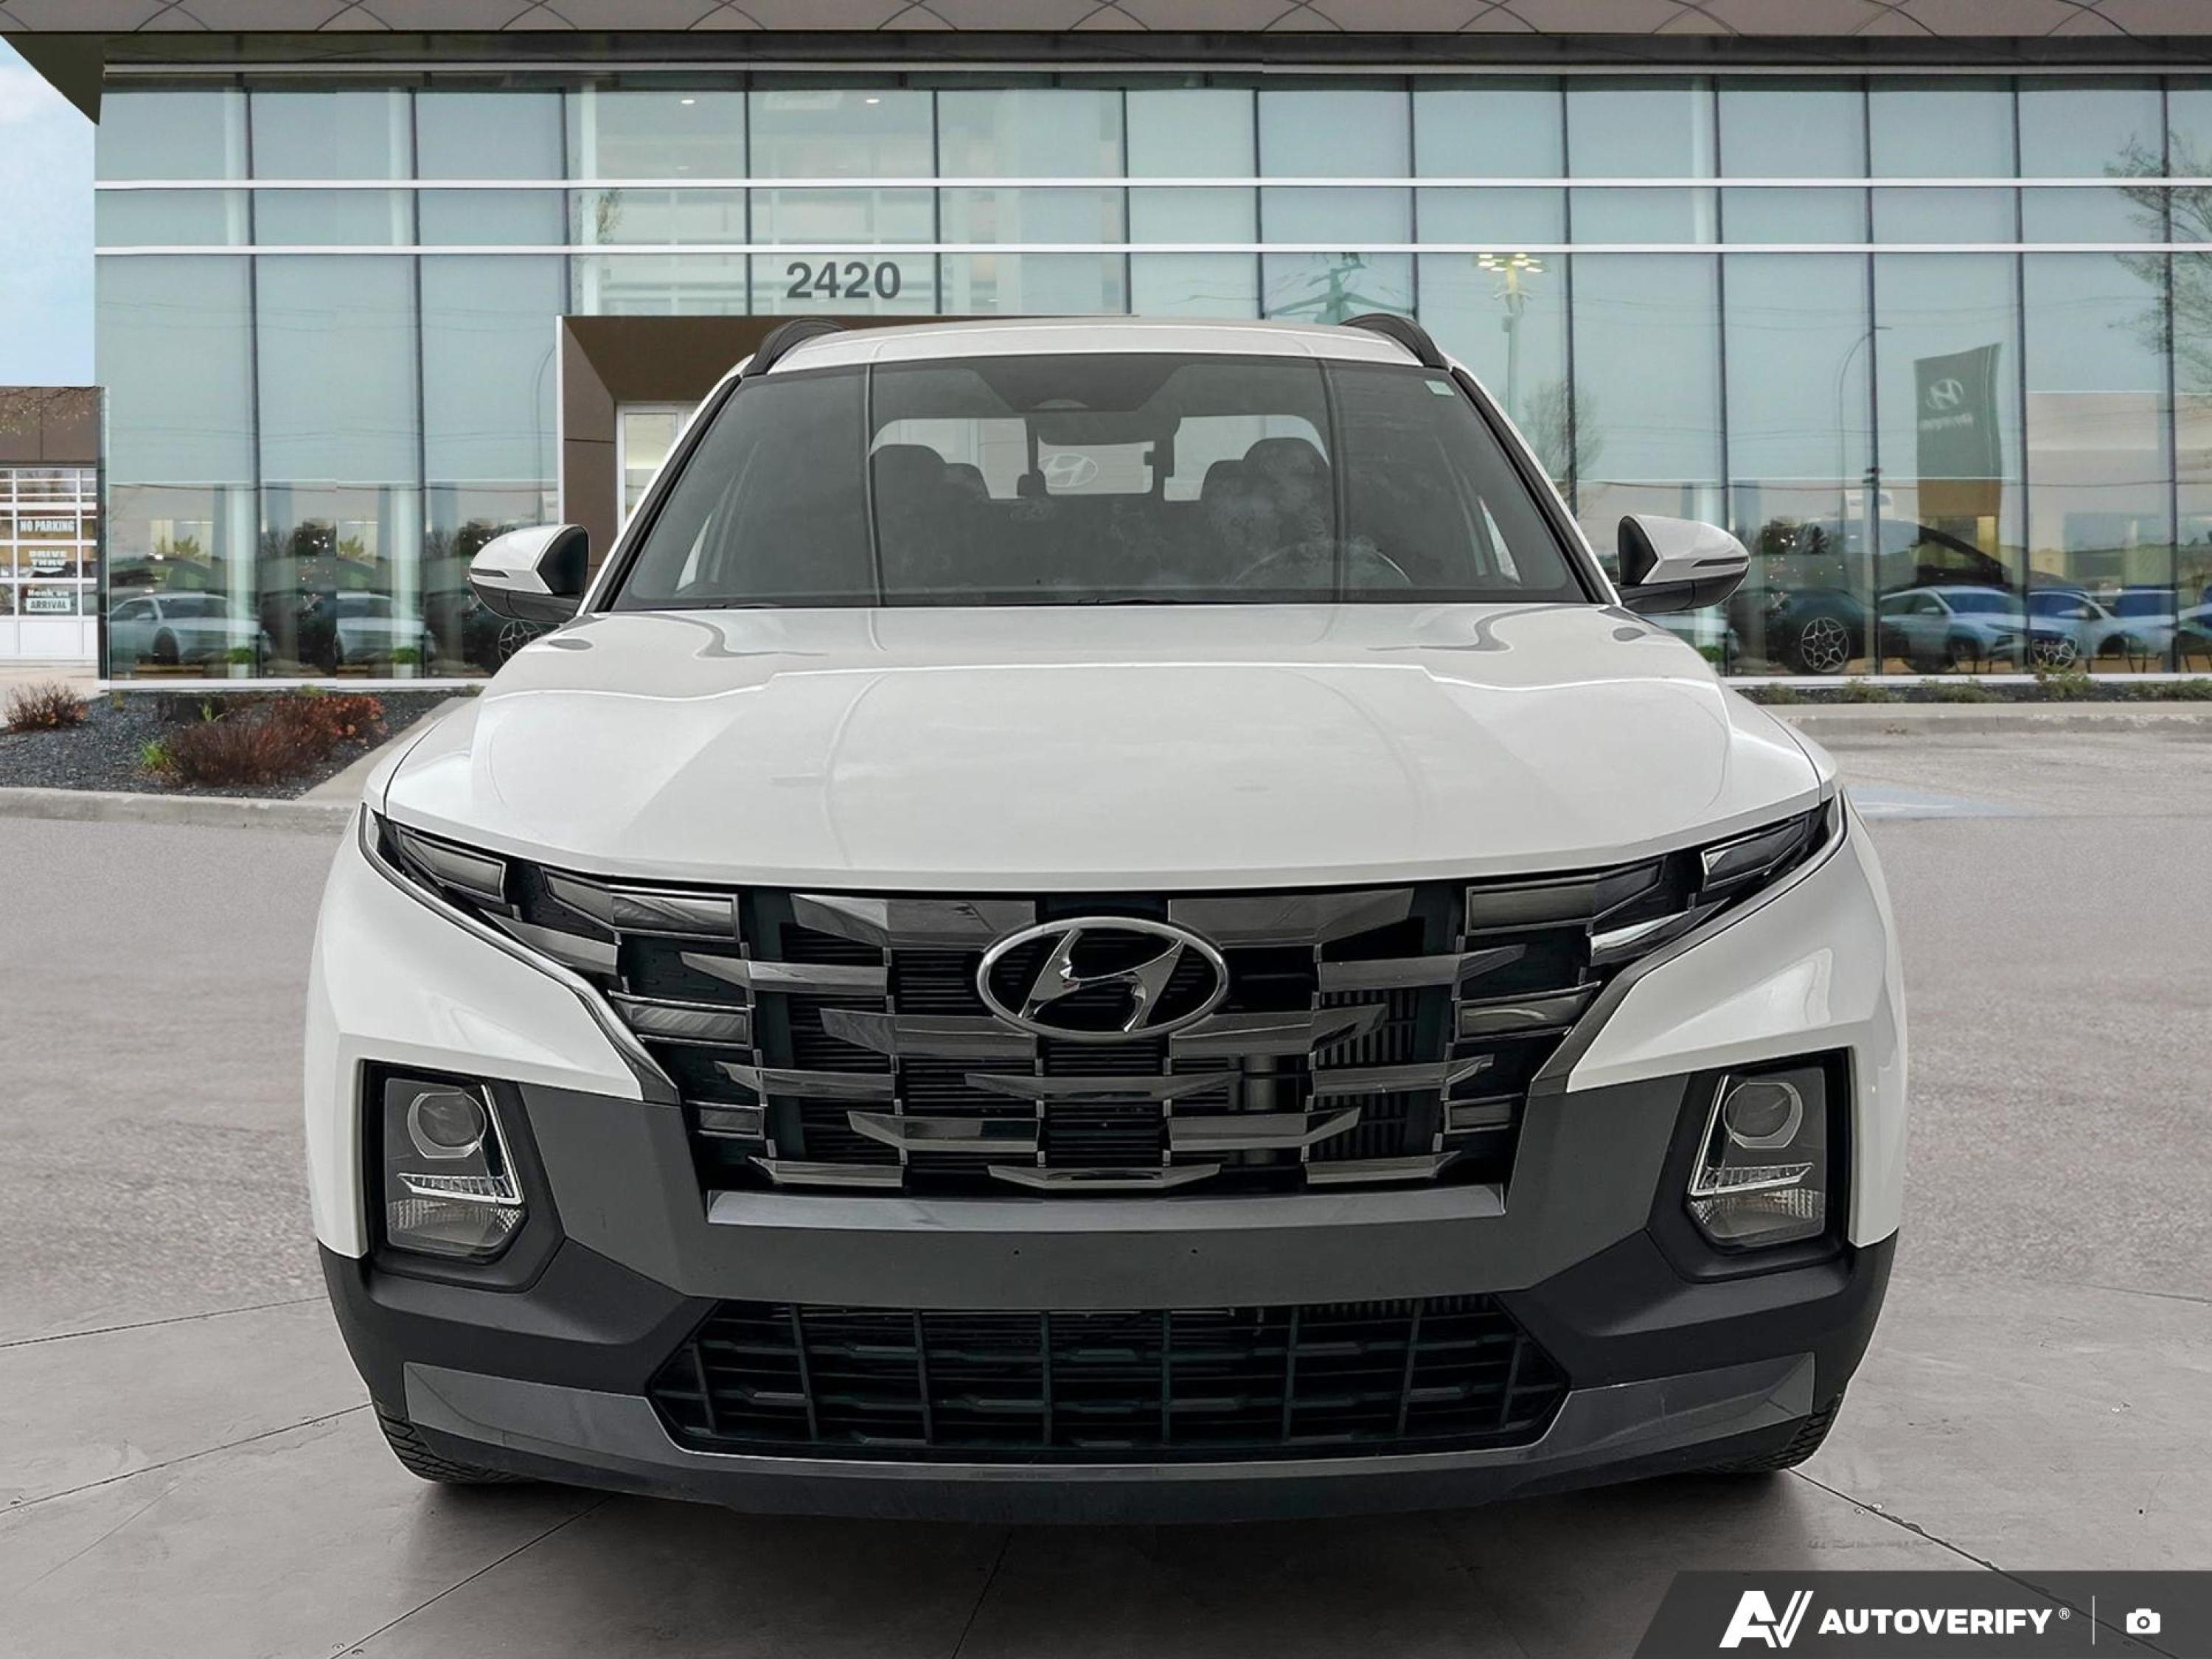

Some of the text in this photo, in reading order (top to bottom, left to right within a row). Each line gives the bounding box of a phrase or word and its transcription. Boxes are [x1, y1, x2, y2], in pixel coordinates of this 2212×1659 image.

[787, 262, 900, 299] 2420
[20, 520, 74, 532] NO PARKING
[28, 550, 67, 558] DRIVE
[29, 599, 66, 609] ARRIVAL
